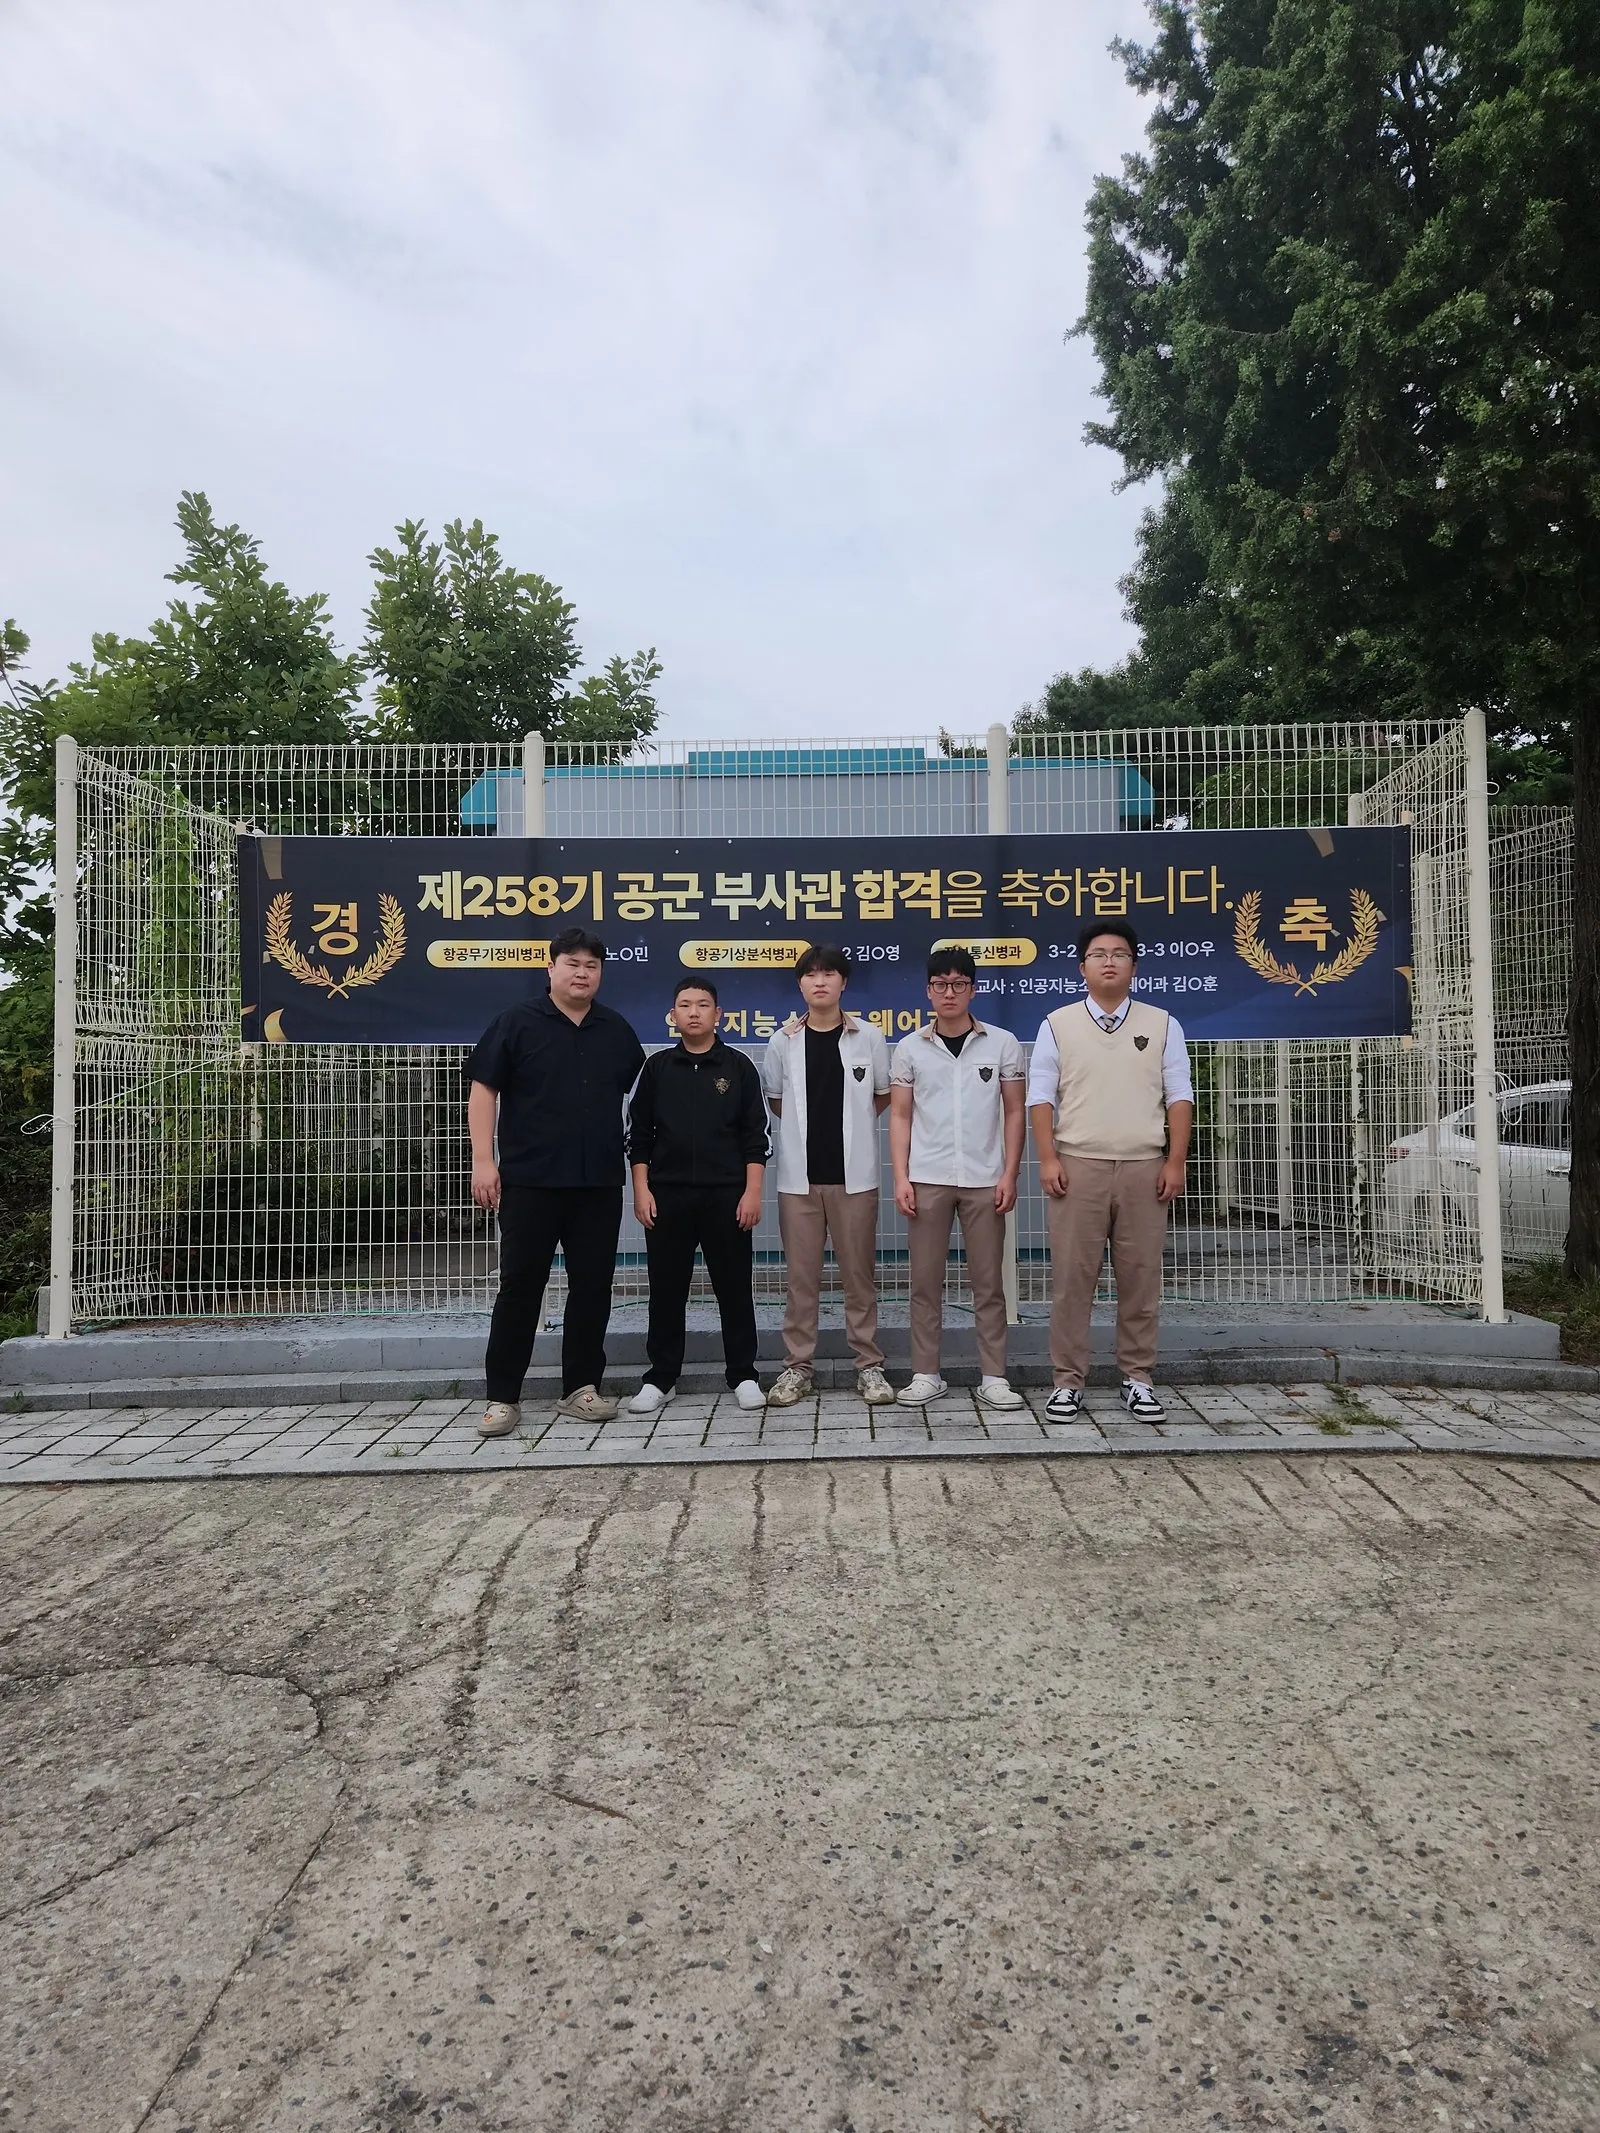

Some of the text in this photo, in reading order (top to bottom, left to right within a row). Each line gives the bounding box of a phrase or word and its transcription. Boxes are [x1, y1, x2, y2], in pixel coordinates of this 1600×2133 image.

[416, 865, 1234, 921] 제258기 공군 부사관 합격을 축하합니다.
[310, 902, 359, 955] 경
[1279, 898, 1333, 951] 축
[443, 947, 546, 962] 항공무기정비병과
[695, 947, 798, 962] 항공기상분석병과
[1136, 942, 1165, 958] 3-3
